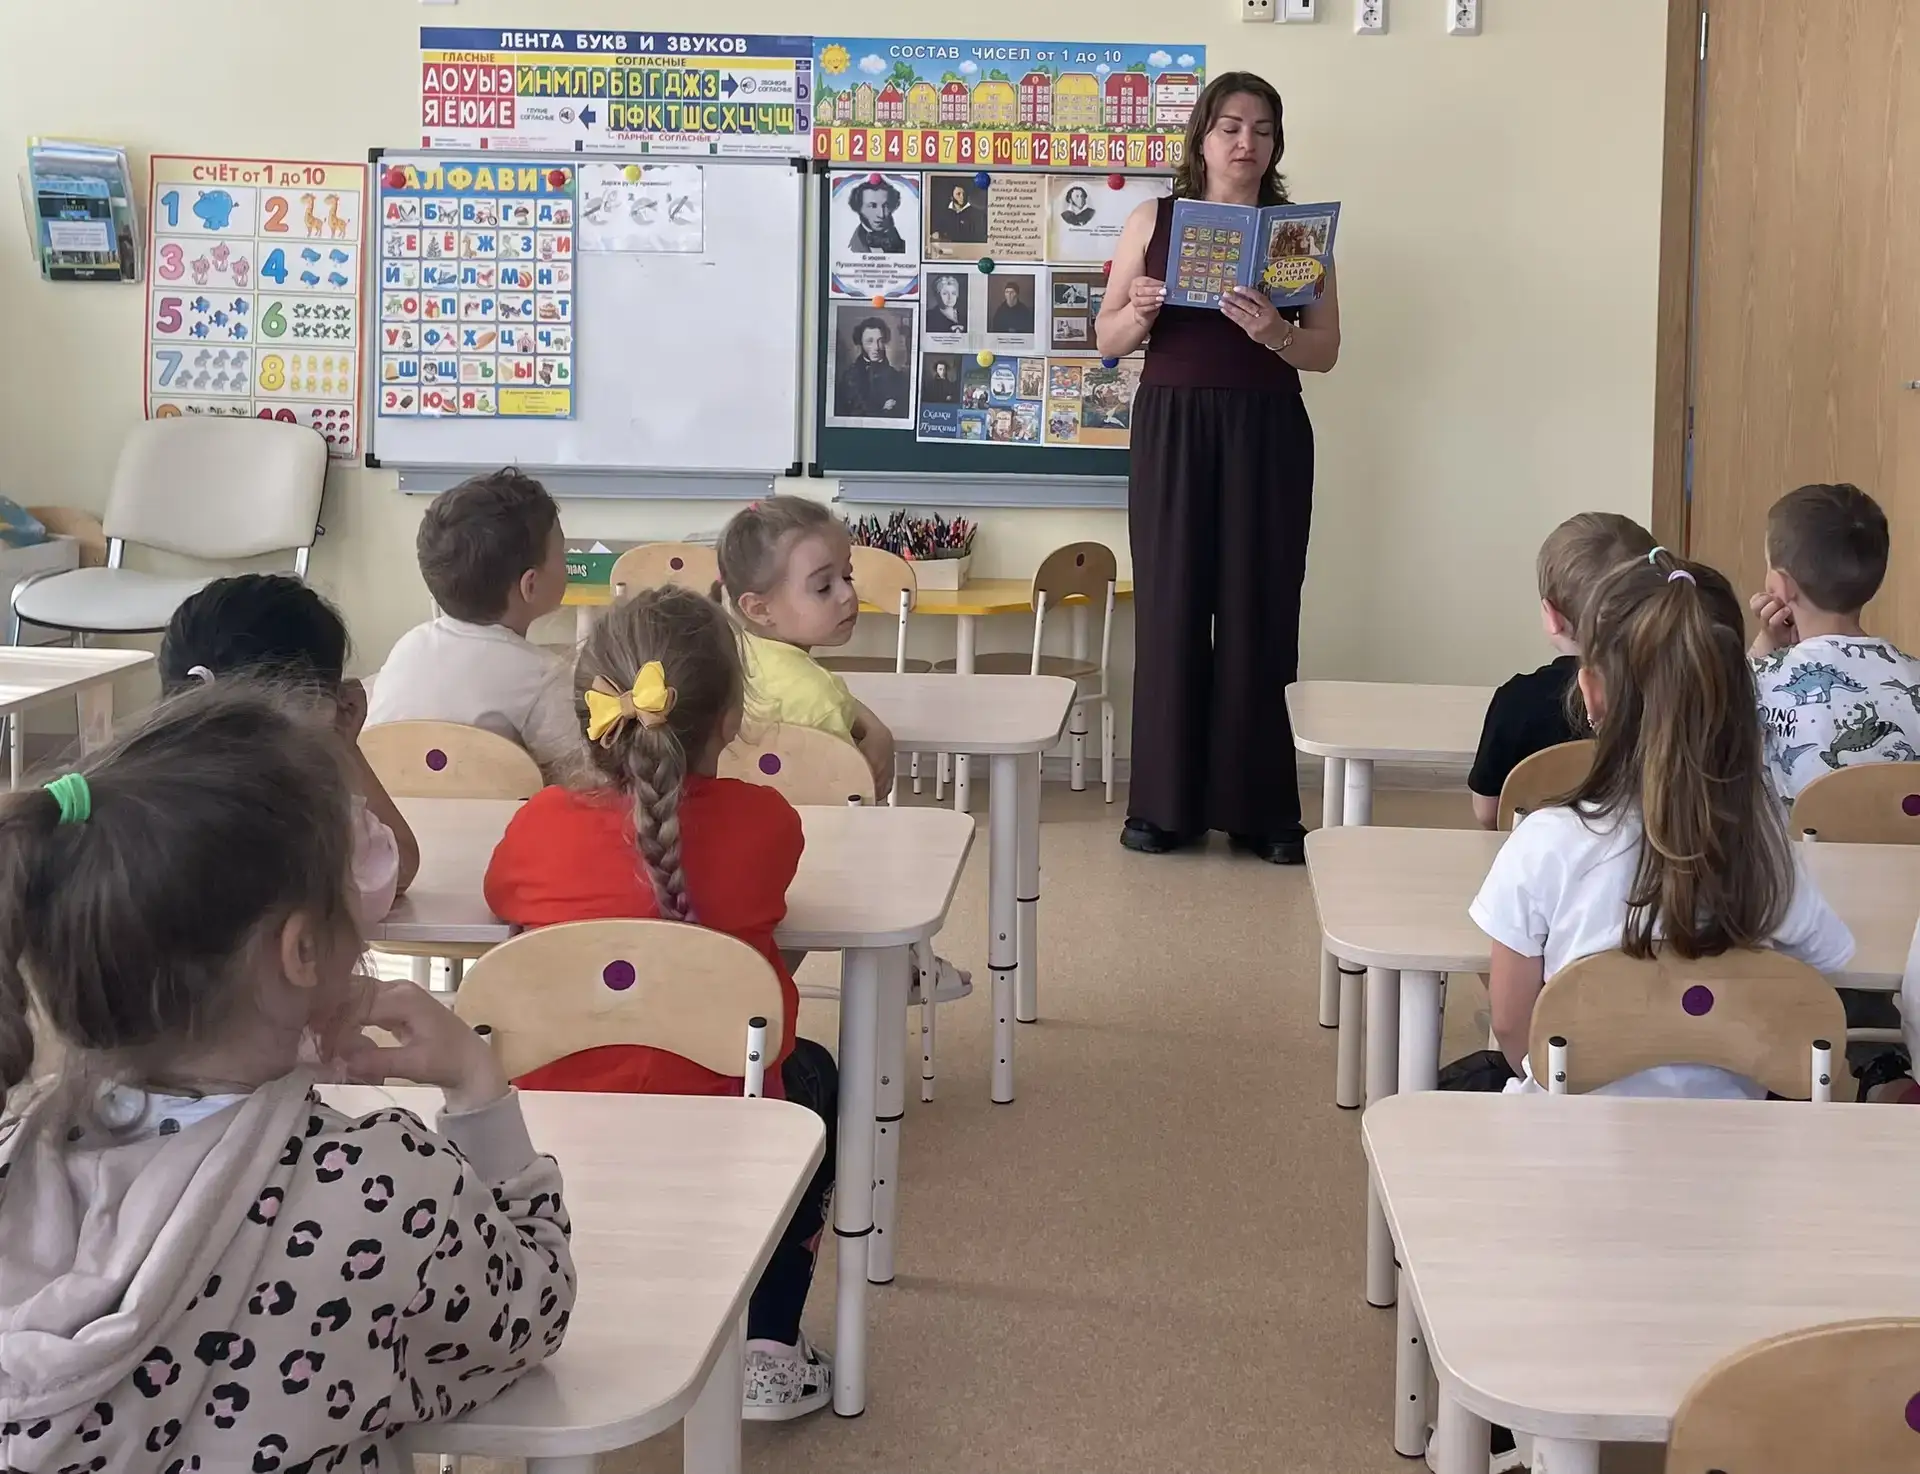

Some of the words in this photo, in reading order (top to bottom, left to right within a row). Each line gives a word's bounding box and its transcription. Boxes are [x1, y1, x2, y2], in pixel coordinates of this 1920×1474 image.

[501, 32, 564, 49] ЛЕНТА
[576, 34, 627, 50] БУКВ
[640, 35, 654, 51] И
[667, 36, 747, 53] ЗВУКОВ
[442, 52, 495, 63] ГЛАСНЫЕ
[616, 56, 686, 67] СОГЛАСНЫЕ
[889, 45, 960, 59] СОСТАВ
[972, 47, 1030, 61] ЧИСЕЛ
[1037, 51, 1054, 61] от
[1061, 50, 1069, 62] 1
[1076, 51, 1097, 63] до
[1104, 50, 1122, 63] 10
[618, 132, 654, 141] ПАРНЫЕ
[659, 134, 712, 143] СОГЛАСНЫЕ
[817, 133, 827, 154] 0
[835, 134, 845, 155] 1
[853, 134, 864, 155] 2
[870, 134, 881, 156] 3
[888, 135, 899, 156] 4
[907, 135, 918, 157] 5
[925, 136, 936, 157] 6
[943, 136, 954, 158] 7
[961, 136, 971, 157] 8
[979, 136, 990, 158] 9
[994, 137, 1010, 159] 10
[1013, 137, 1028, 159] 11
[1032, 139, 1049, 160] 12
[1052, 138, 1068, 160] 13
[1070, 139, 1087, 160] 14
[1089, 139, 1106, 161] 15
[1109, 140, 1125, 162] 16
[1129, 140, 1145, 162] 17
[1148, 140, 1164, 161] 18
[1167, 141, 1183, 162] 19
[193, 164, 239, 182] СЧЁТ
[243, 171, 260, 182] от
[263, 165, 273, 184] 1
[280, 172, 300, 186] до
[303, 166, 325, 185] 10
[404, 166, 557, 193] АЛФАВИТ
[161, 190, 179, 227] 1
[264, 196, 289, 232] 2
[386, 203, 400, 220] А
[424, 203, 438, 220] Б
[463, 204, 475, 220] В
[502, 205, 513, 221] Г
[539, 205, 552, 222] Д
[406, 234, 416, 250] Е
[444, 231, 454, 251] Ё
[477, 236, 495, 251] Ж
[521, 236, 532, 251] З
[557, 237, 571, 252] И
[159, 243, 185, 281] 3
[261, 248, 288, 284] 4
[1276, 260, 1314, 269] Сказка
[386, 263, 399, 283] Й
[424, 267, 437, 283] К
[461, 268, 476, 284] Л
[501, 268, 518, 284] М
[538, 269, 552, 284] Н
[1270, 274, 1315, 283] Салтане
[403, 298, 417, 313] О
[442, 298, 455, 314] П
[481, 299, 494, 315] Р
[521, 299, 532, 315] С
[558, 300, 570, 315] Т
[156, 297, 183, 333] 5
[261, 302, 287, 338] 6
[385, 329, 399, 345] У
[424, 329, 440, 346] Ф
[463, 330, 477, 346] Х
[501, 330, 514, 346] Ц
[538, 331, 551, 347] Ч
[155, 351, 183, 387] 7
[259, 355, 285, 391] 8
[399, 361, 417, 377] Ш
[438, 361, 457, 379] Щ
[479, 362, 493, 378] Ъ
[514, 362, 532, 378] Ы
[558, 362, 569, 378] Ь
[385, 392, 397, 408] Э
[423, 392, 442, 408] Ю
[462, 392, 475, 408] Я
[923, 409, 951, 420] Сказки
[920, 422, 956, 433] Пушкина
